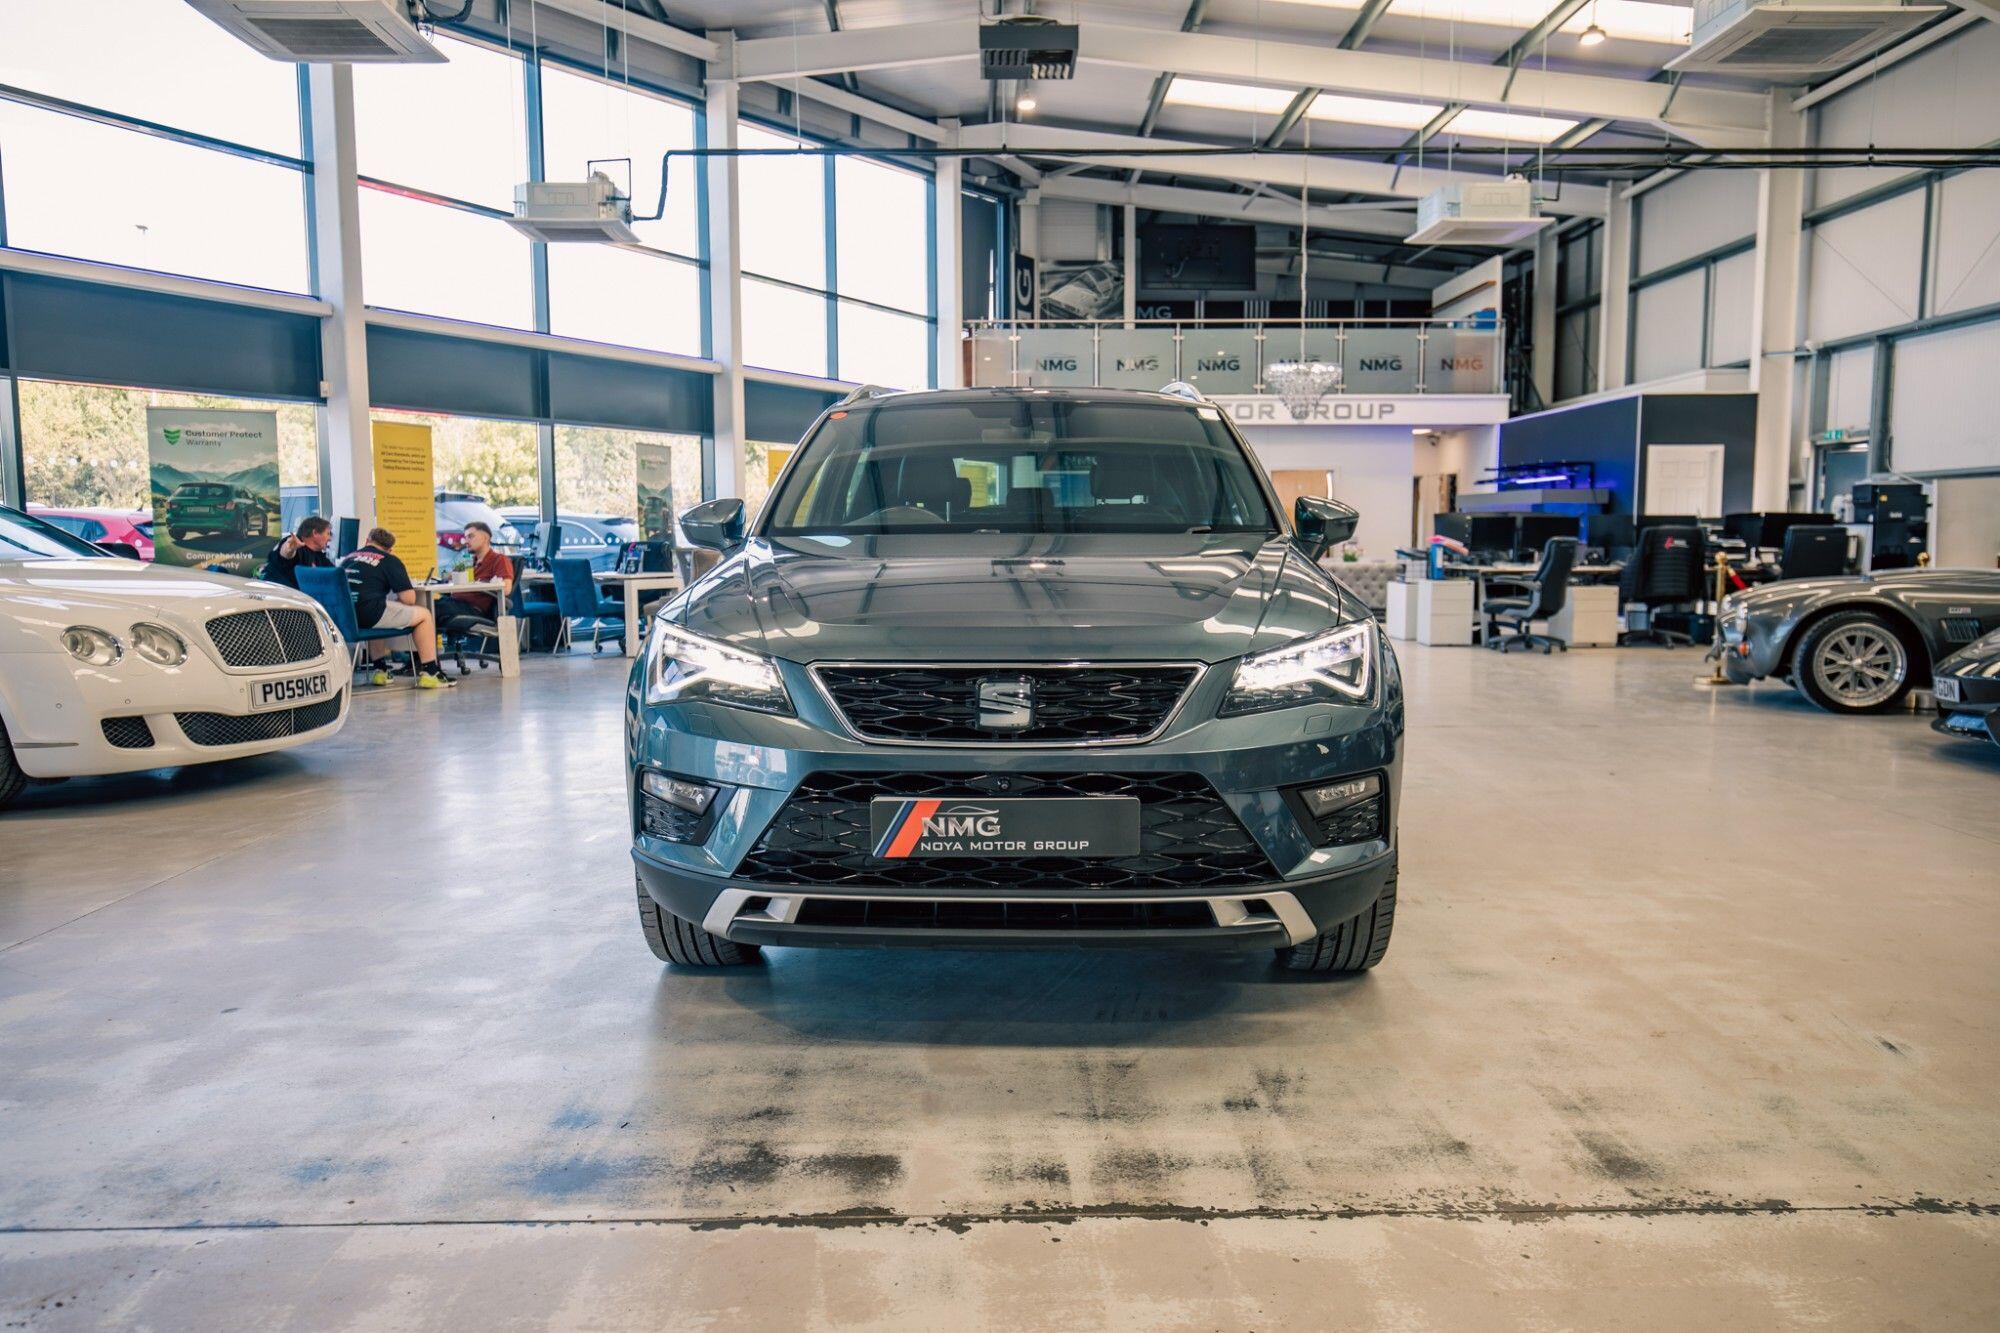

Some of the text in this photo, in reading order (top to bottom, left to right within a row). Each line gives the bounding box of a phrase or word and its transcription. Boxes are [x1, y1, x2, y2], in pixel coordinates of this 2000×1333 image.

[1035, 359, 1078, 371] NMG
[1198, 359, 1240, 371] NMG
[1360, 358, 1403, 371] NMG
[1441, 358, 1484, 371] NMG
[185, 430, 263, 439] Customer Protect
[185, 439, 222, 447] Warranty
[185, 551, 254, 561] Comprehensive
[921, 816, 1001, 837] NMG
[920, 840, 1090, 851] NOYA MOTOR GROUP
